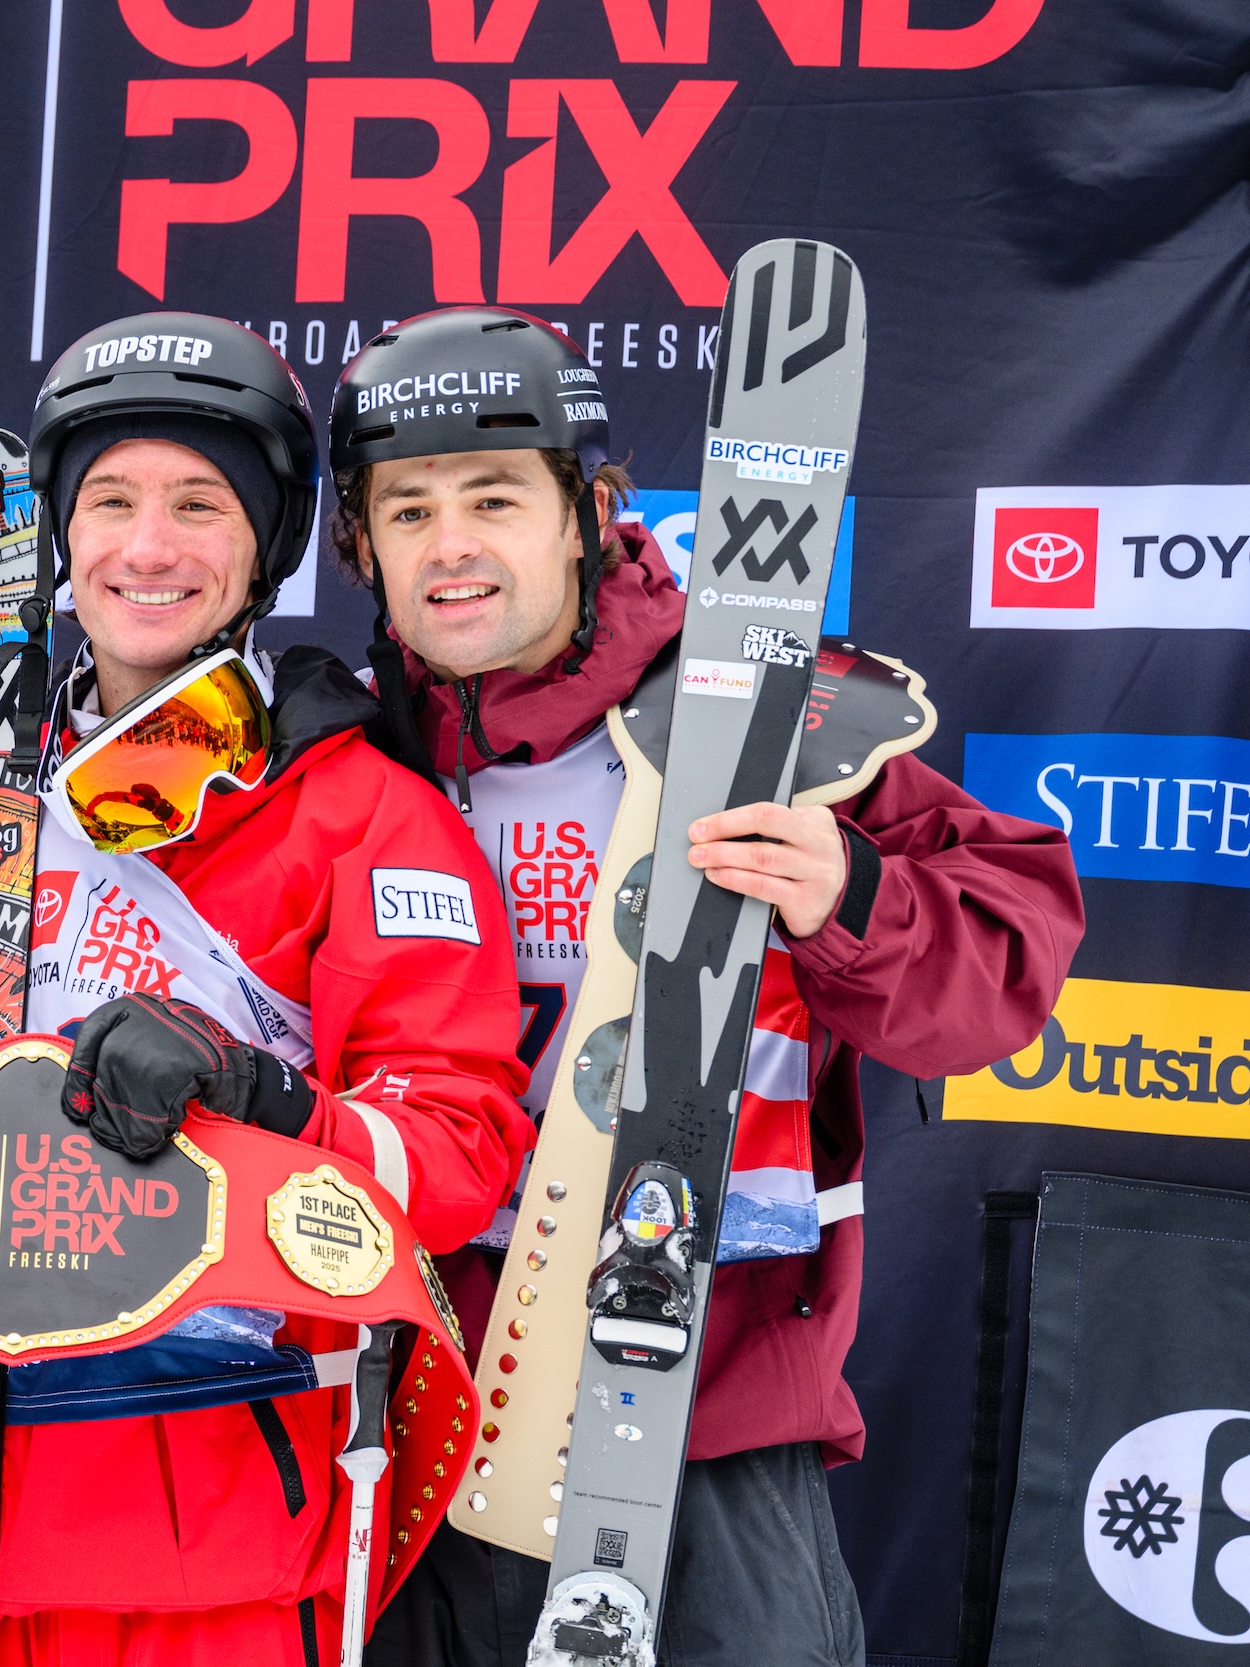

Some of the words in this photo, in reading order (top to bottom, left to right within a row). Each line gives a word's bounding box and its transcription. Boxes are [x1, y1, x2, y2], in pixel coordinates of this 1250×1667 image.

[117, 77, 739, 308] PRIX
[85, 334, 213, 373] TOPSTEP
[356, 371, 521, 415] BIRCHCLIFF
[389, 401, 480, 424] ENERGY
[710, 440, 847, 471] BIRCHCLIFF
[739, 465, 811, 482] ENERGY
[721, 593, 817, 612] COMPASS
[745, 624, 786, 646] SKI
[743, 641, 810, 668] WEST
[512, 821, 595, 860] U.S.
[381, 886, 473, 928] STIFEL
[630, 888, 646, 914] 2025
[71, 978, 131, 1000] FREES
[15, 1133, 101, 1174] U.S.
[10, 1172, 179, 1218] GRAND
[299, 1195, 319, 1212] 1ST
[321, 1199, 356, 1222] PLACE
[10, 1210, 126, 1256] PRIX
[327, 1225, 359, 1244] FREESKI
[9, 1251, 89, 1271] FREESKI
[310, 1243, 350, 1264] HALFPIPE
[321, 1261, 341, 1272] 2025
[574, 1490, 587, 1498] team
[589, 1492, 629, 1504] recommended
[630, 1499, 643, 1507] boot
[644, 1501, 663, 1510] center
